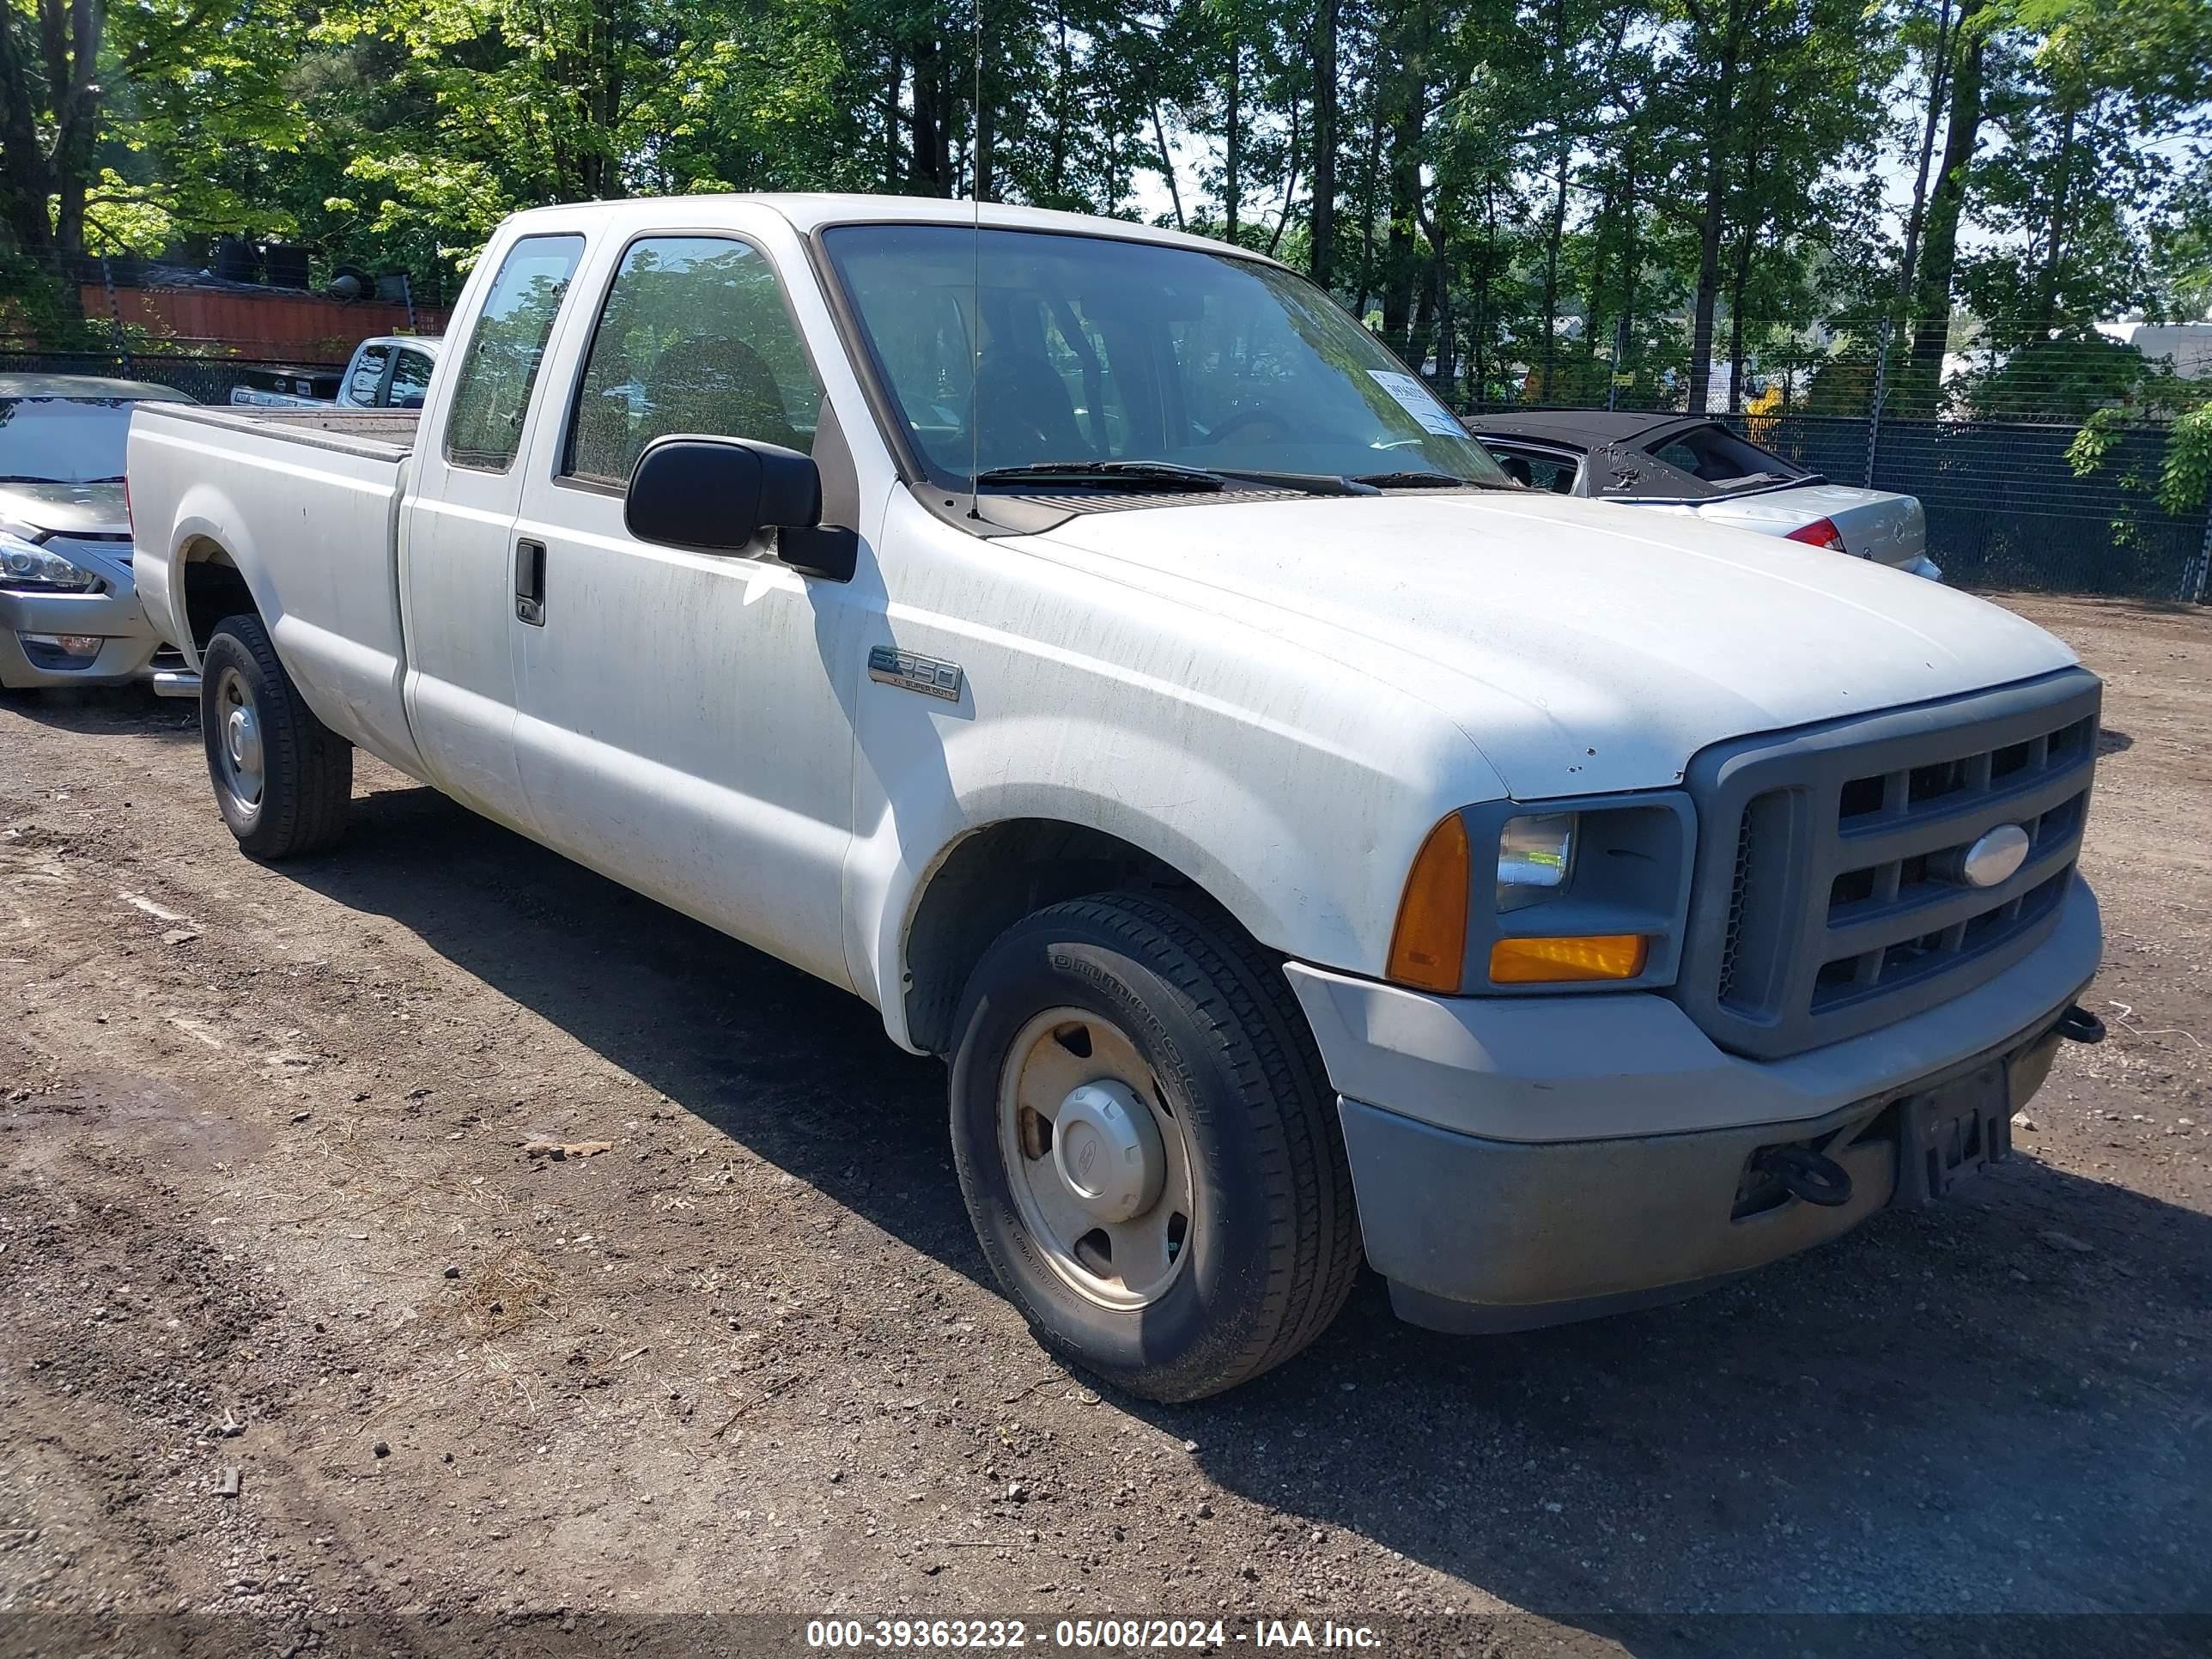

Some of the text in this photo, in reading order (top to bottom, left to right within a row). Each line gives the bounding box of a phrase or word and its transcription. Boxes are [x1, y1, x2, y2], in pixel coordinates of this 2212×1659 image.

[892, 677, 954, 698] XL SUPER DUTY
[1047, 952, 1210, 1125] ommercial
